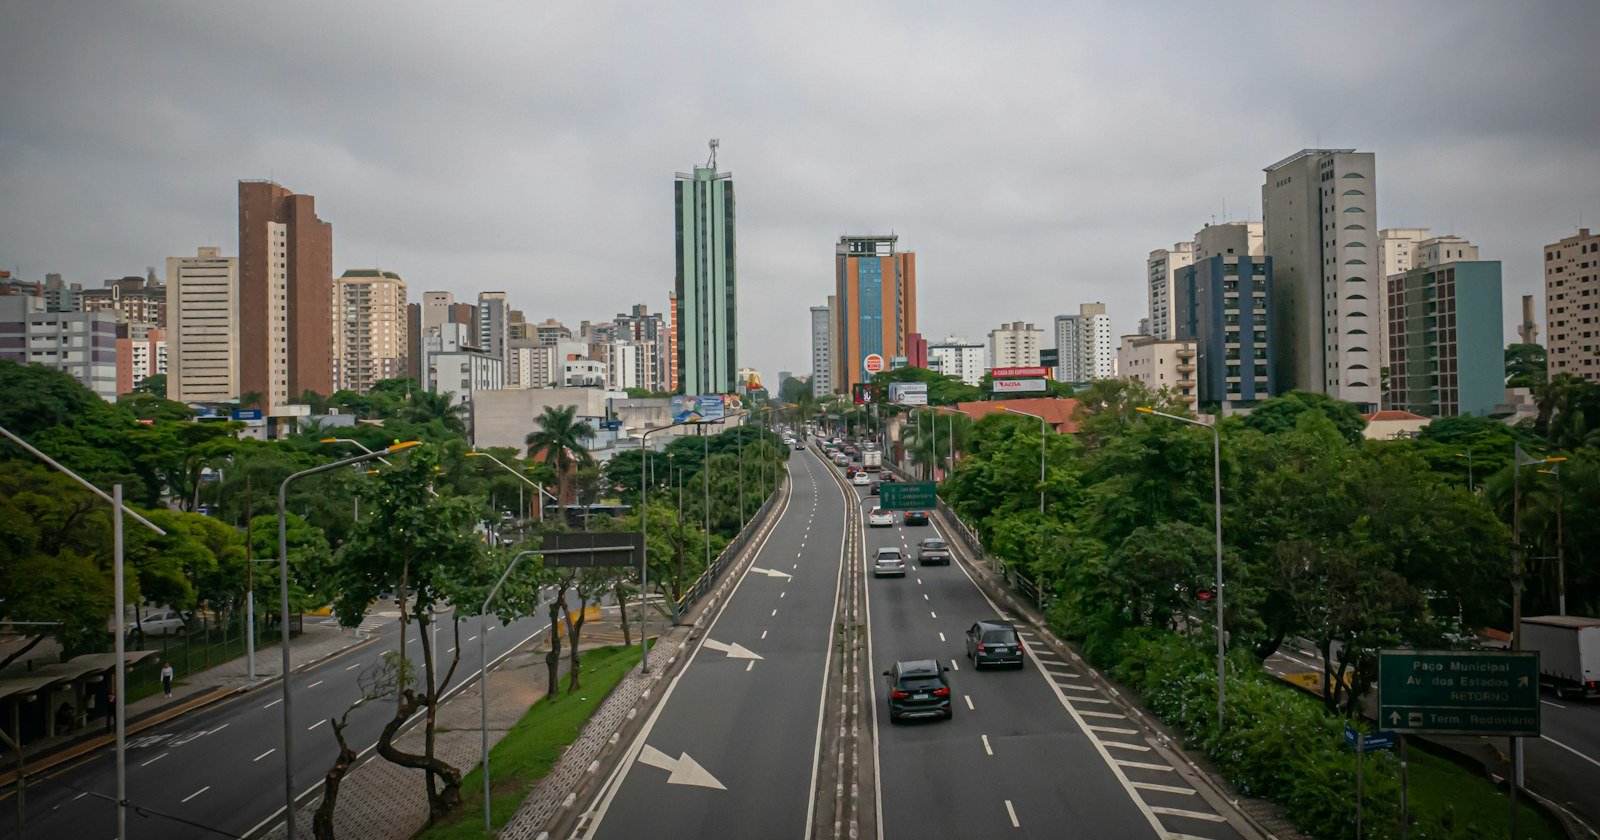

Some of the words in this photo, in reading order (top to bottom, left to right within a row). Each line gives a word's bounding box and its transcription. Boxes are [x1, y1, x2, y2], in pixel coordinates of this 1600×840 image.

[1413, 661, 1443, 672] Paço
[1450, 661, 1510, 673] Municipal
[1432, 676, 1453, 686] dos
[1460, 676, 1509, 687] Estados
[1450, 691, 1509, 701] RETORNO
[1430, 714, 1462, 724] Term.
[1470, 715, 1535, 725] Rodoviário
